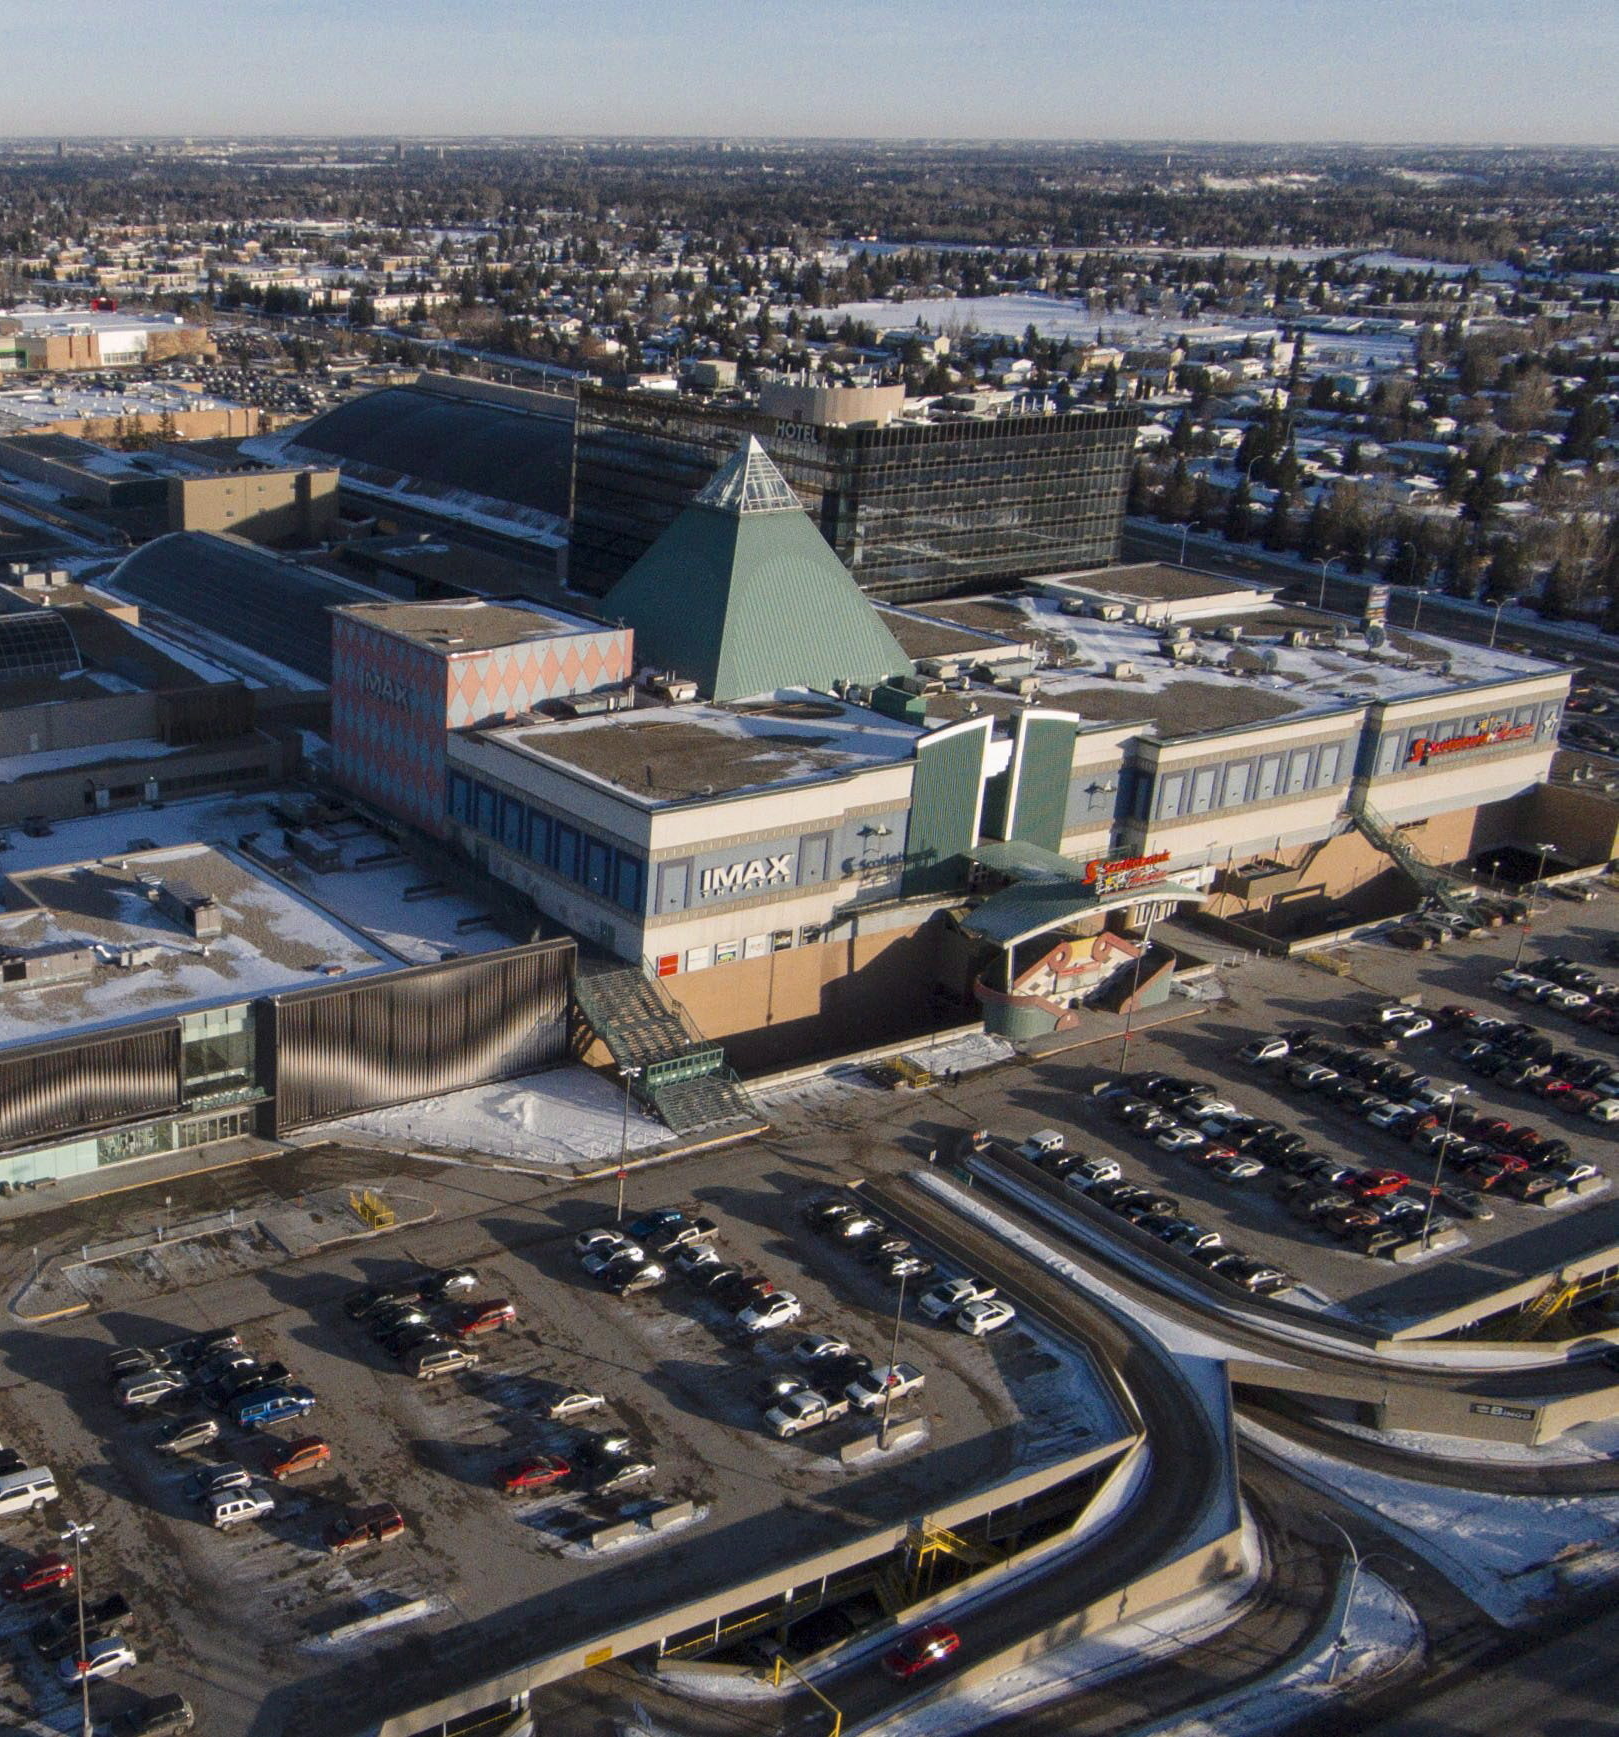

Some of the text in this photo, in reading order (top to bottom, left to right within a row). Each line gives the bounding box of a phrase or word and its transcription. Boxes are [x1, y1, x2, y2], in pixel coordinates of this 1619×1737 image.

[774, 420, 818, 443] HOTEL
[358, 669, 410, 707] IMAX
[700, 874, 792, 899] THEATRE
[702, 853, 792, 890] IMAX
